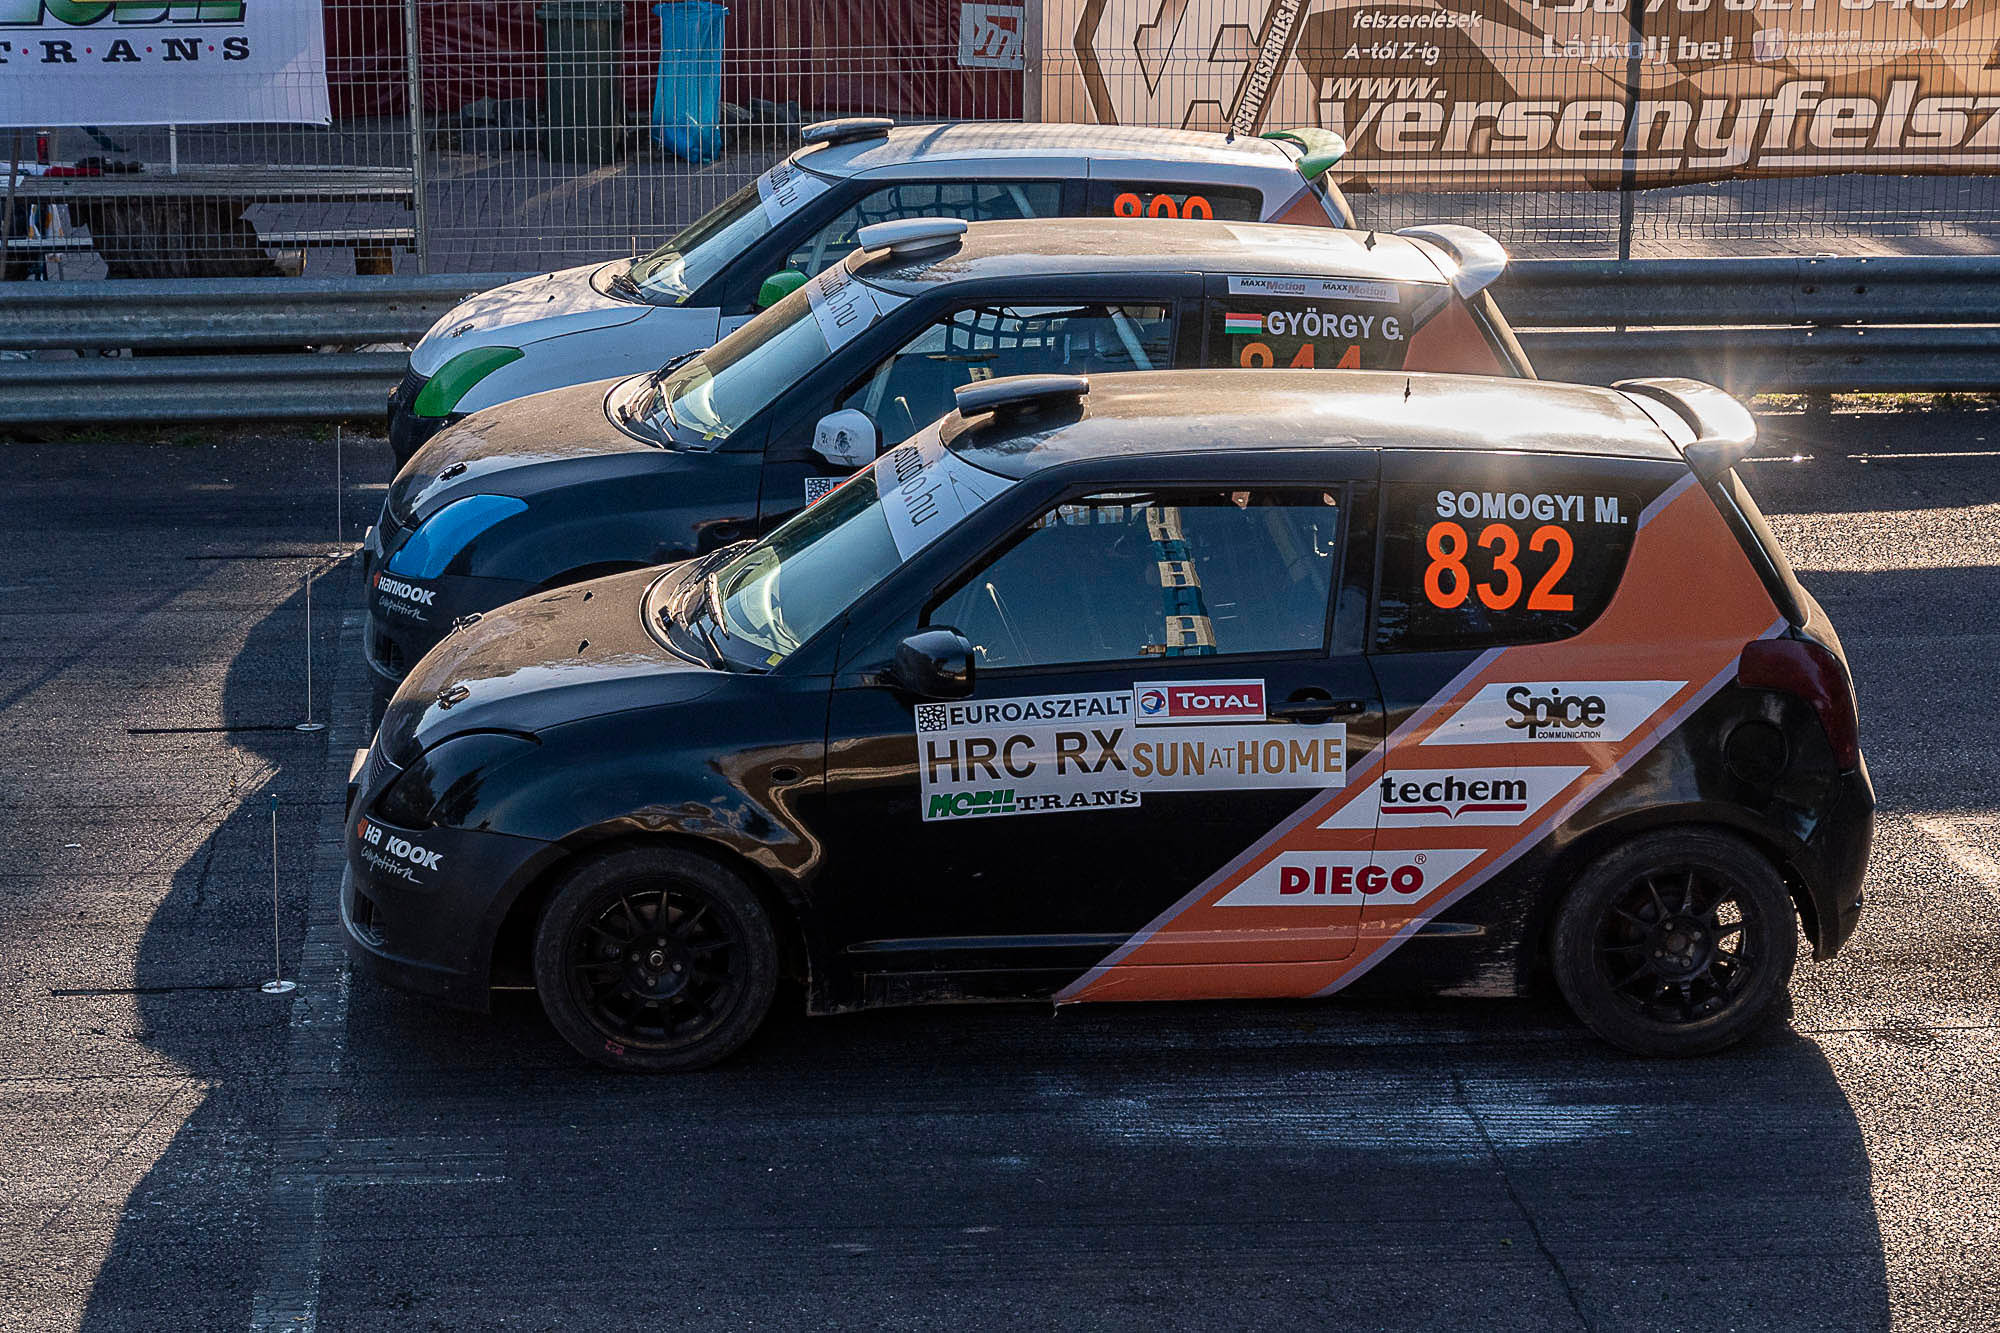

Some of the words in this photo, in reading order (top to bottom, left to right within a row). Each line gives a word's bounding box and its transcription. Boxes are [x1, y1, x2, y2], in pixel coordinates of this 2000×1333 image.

[1352, 10, 1483, 29] felszerelések
[1343, 41, 1397, 60] A-tól
[1399, 41, 1440, 66] Z-ig
[1544, 33, 1670, 65] Lájkolj
[1678, 35, 1733, 60] be!
[1320, 77, 1447, 99] www.
[1267, 307, 1374, 339] GYÖRGY
[1382, 316, 1404, 341] G.
[1437, 491, 1584, 522] SOMOGYI
[1595, 497, 1628, 524] M.
[1424, 521, 1574, 611] 832
[951, 696, 1131, 725] EUROASZFALT
[1176, 692, 1258, 709] TOTAL
[1505, 685, 1606, 738] Spice
[1537, 731, 1601, 739] COMMUNICATION
[927, 735, 1037, 784] HRC
[1056, 728, 1127, 776] RX
[1132, 742, 1205, 778] SUN
[1209, 747, 1235, 768] AT
[1237, 739, 1342, 775] HOME
[1016, 789, 1138, 812] TRANS
[1380, 776, 1527, 803] techem
